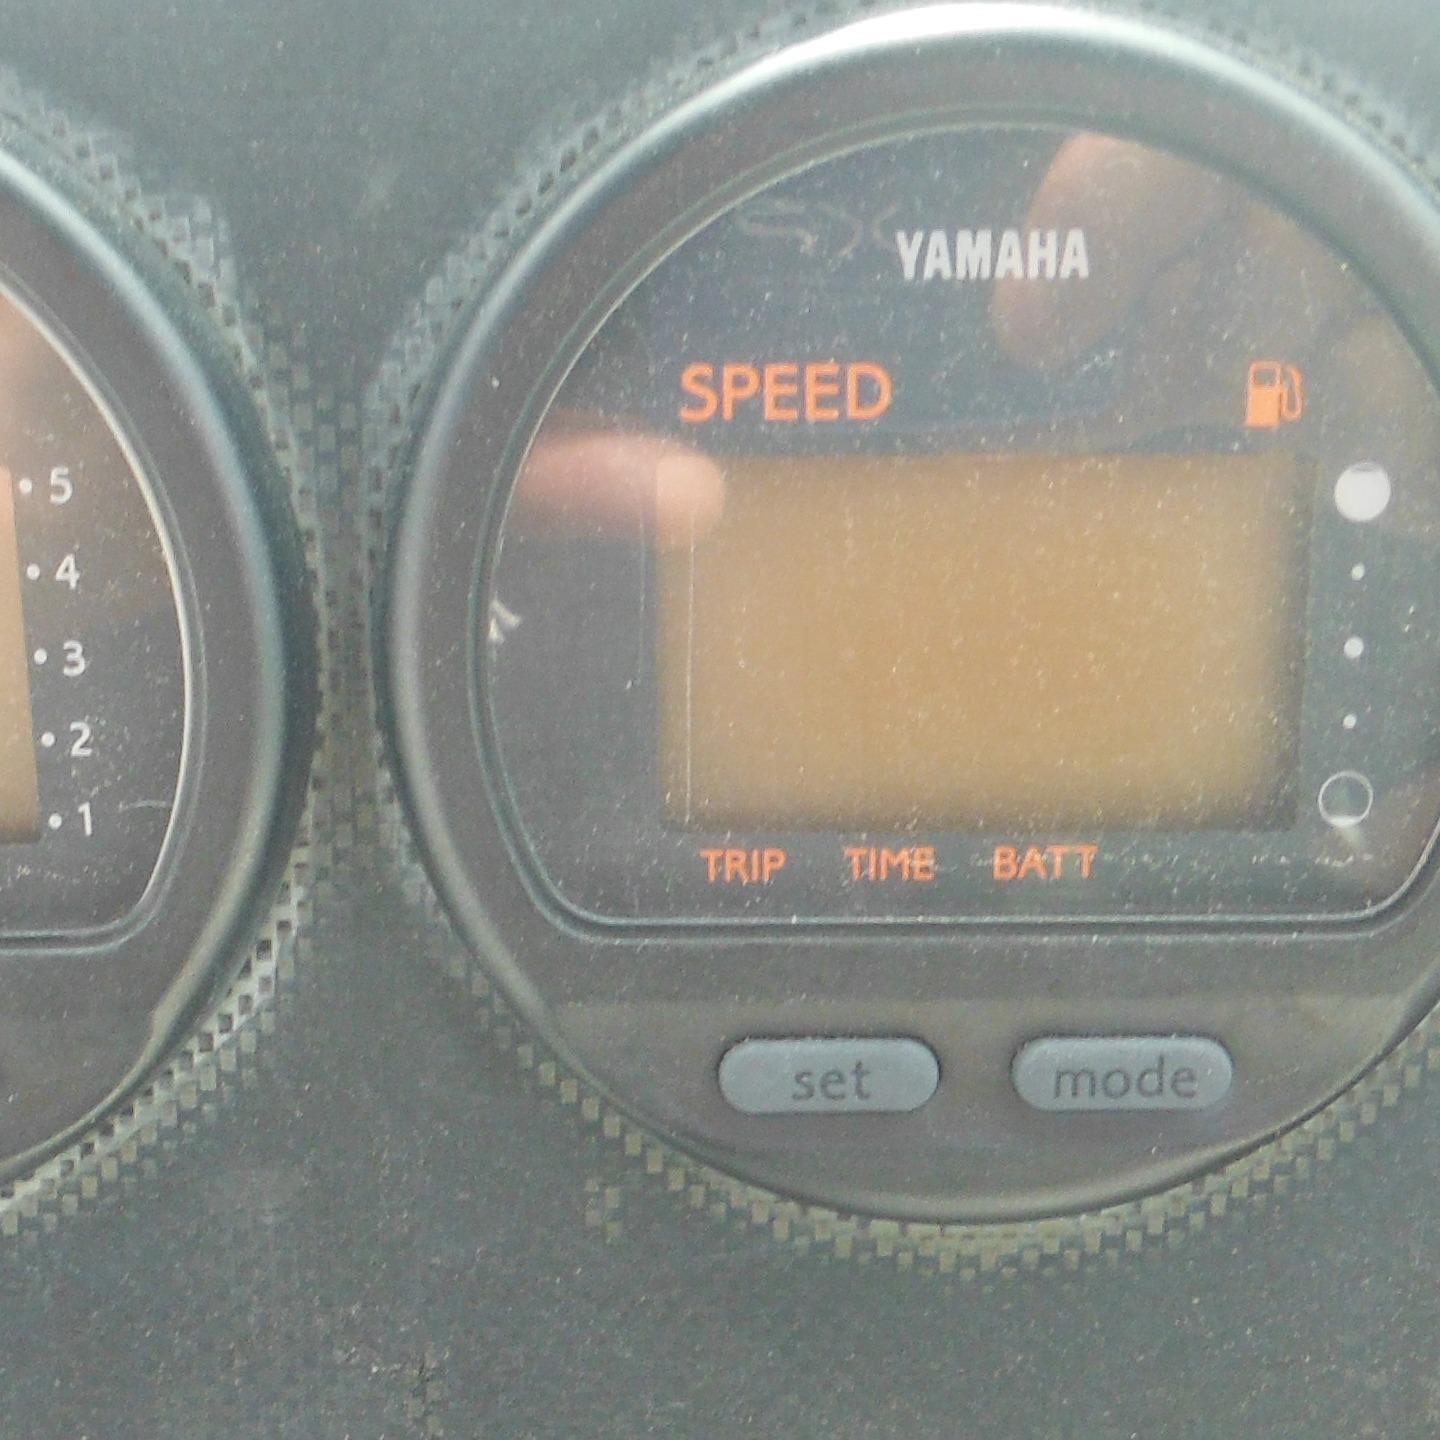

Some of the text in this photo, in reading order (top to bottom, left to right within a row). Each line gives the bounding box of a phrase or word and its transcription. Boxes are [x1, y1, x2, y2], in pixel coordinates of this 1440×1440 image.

[895, 228, 1090, 282] YAMAHA
[679, 361, 893, 423] SPEED
[47, 469, 74, 504] 5
[53, 553, 81, 589] 4
[61, 641, 87, 677] 3
[69, 723, 94, 758] 2
[77, 802, 95, 838] 1
[699, 843, 1098, 884] TRIP TIME BATT
[791, 1060, 872, 1101] set
[1053, 1056, 1200, 1100] mode
